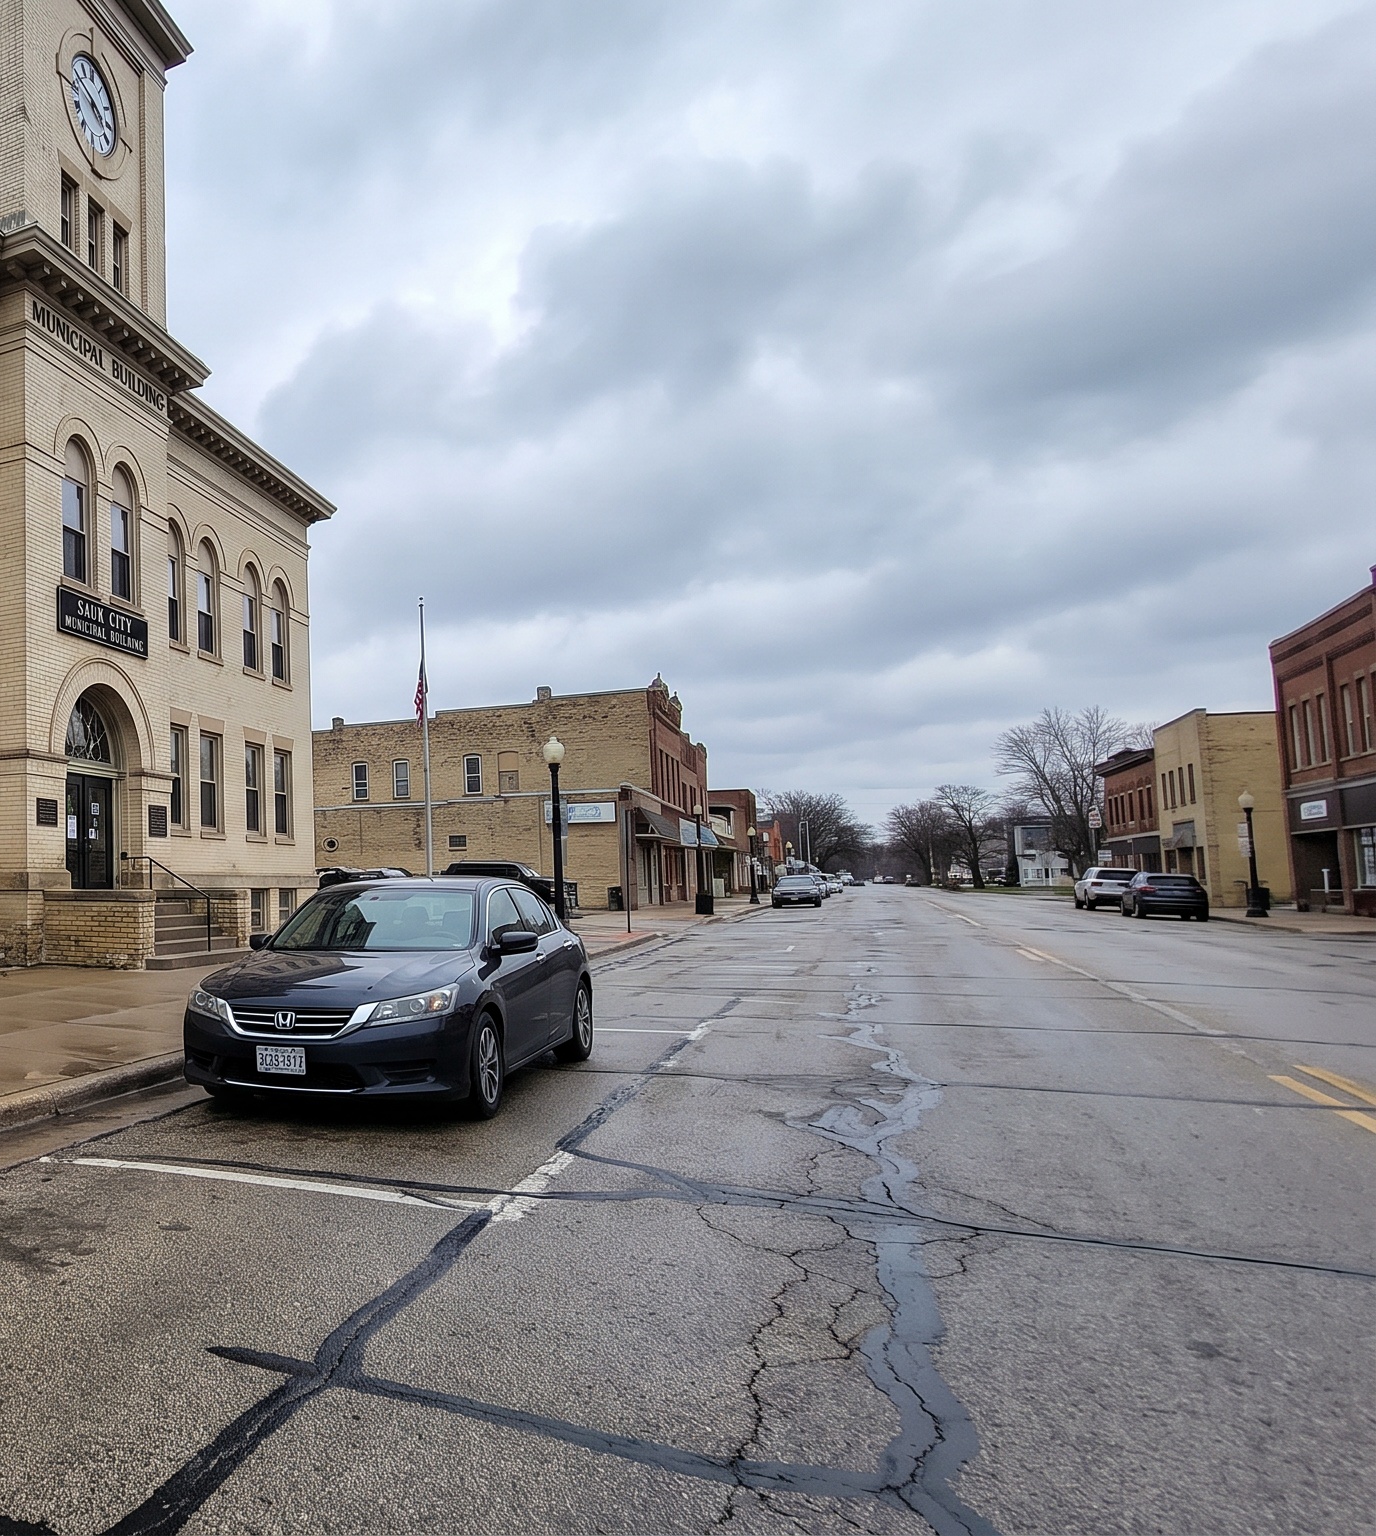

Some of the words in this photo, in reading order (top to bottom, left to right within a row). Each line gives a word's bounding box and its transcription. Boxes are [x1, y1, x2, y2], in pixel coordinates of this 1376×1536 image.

[32, 300, 106, 371] MUNICIPAL
[111, 358, 165, 412] BUILDING
[77, 600, 104, 624] SAUK
[109, 612, 132, 634] CITY
